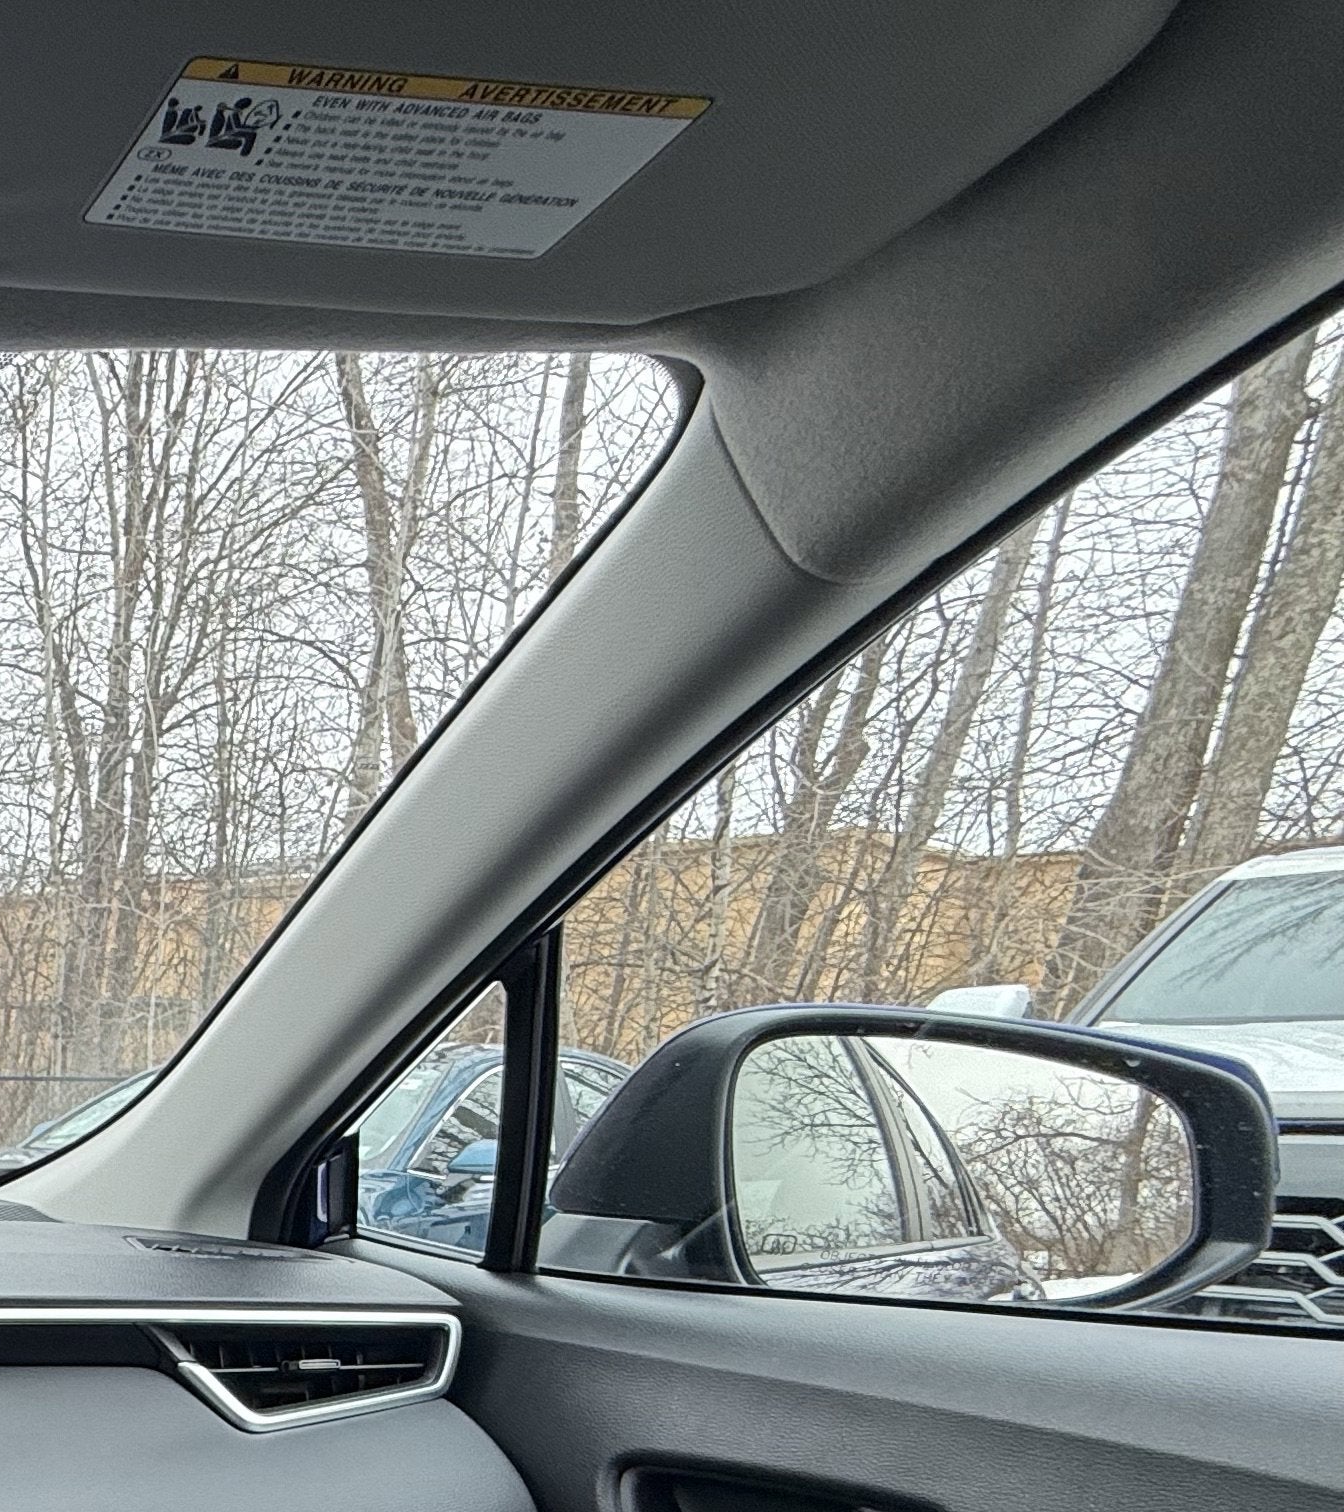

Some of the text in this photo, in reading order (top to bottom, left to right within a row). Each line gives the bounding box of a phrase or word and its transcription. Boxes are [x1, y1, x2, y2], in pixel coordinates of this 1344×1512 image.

[287, 68, 678, 114] WARNING AVERTISSEMENT
[313, 95, 543, 125] EVEN WITH ADVANCED AIR BAGS
[191, 167, 226, 180] AVEC
[229, 171, 256, 182] DES
[260, 173, 322, 187] COUSSINS
[323, 179, 344, 190] DE
